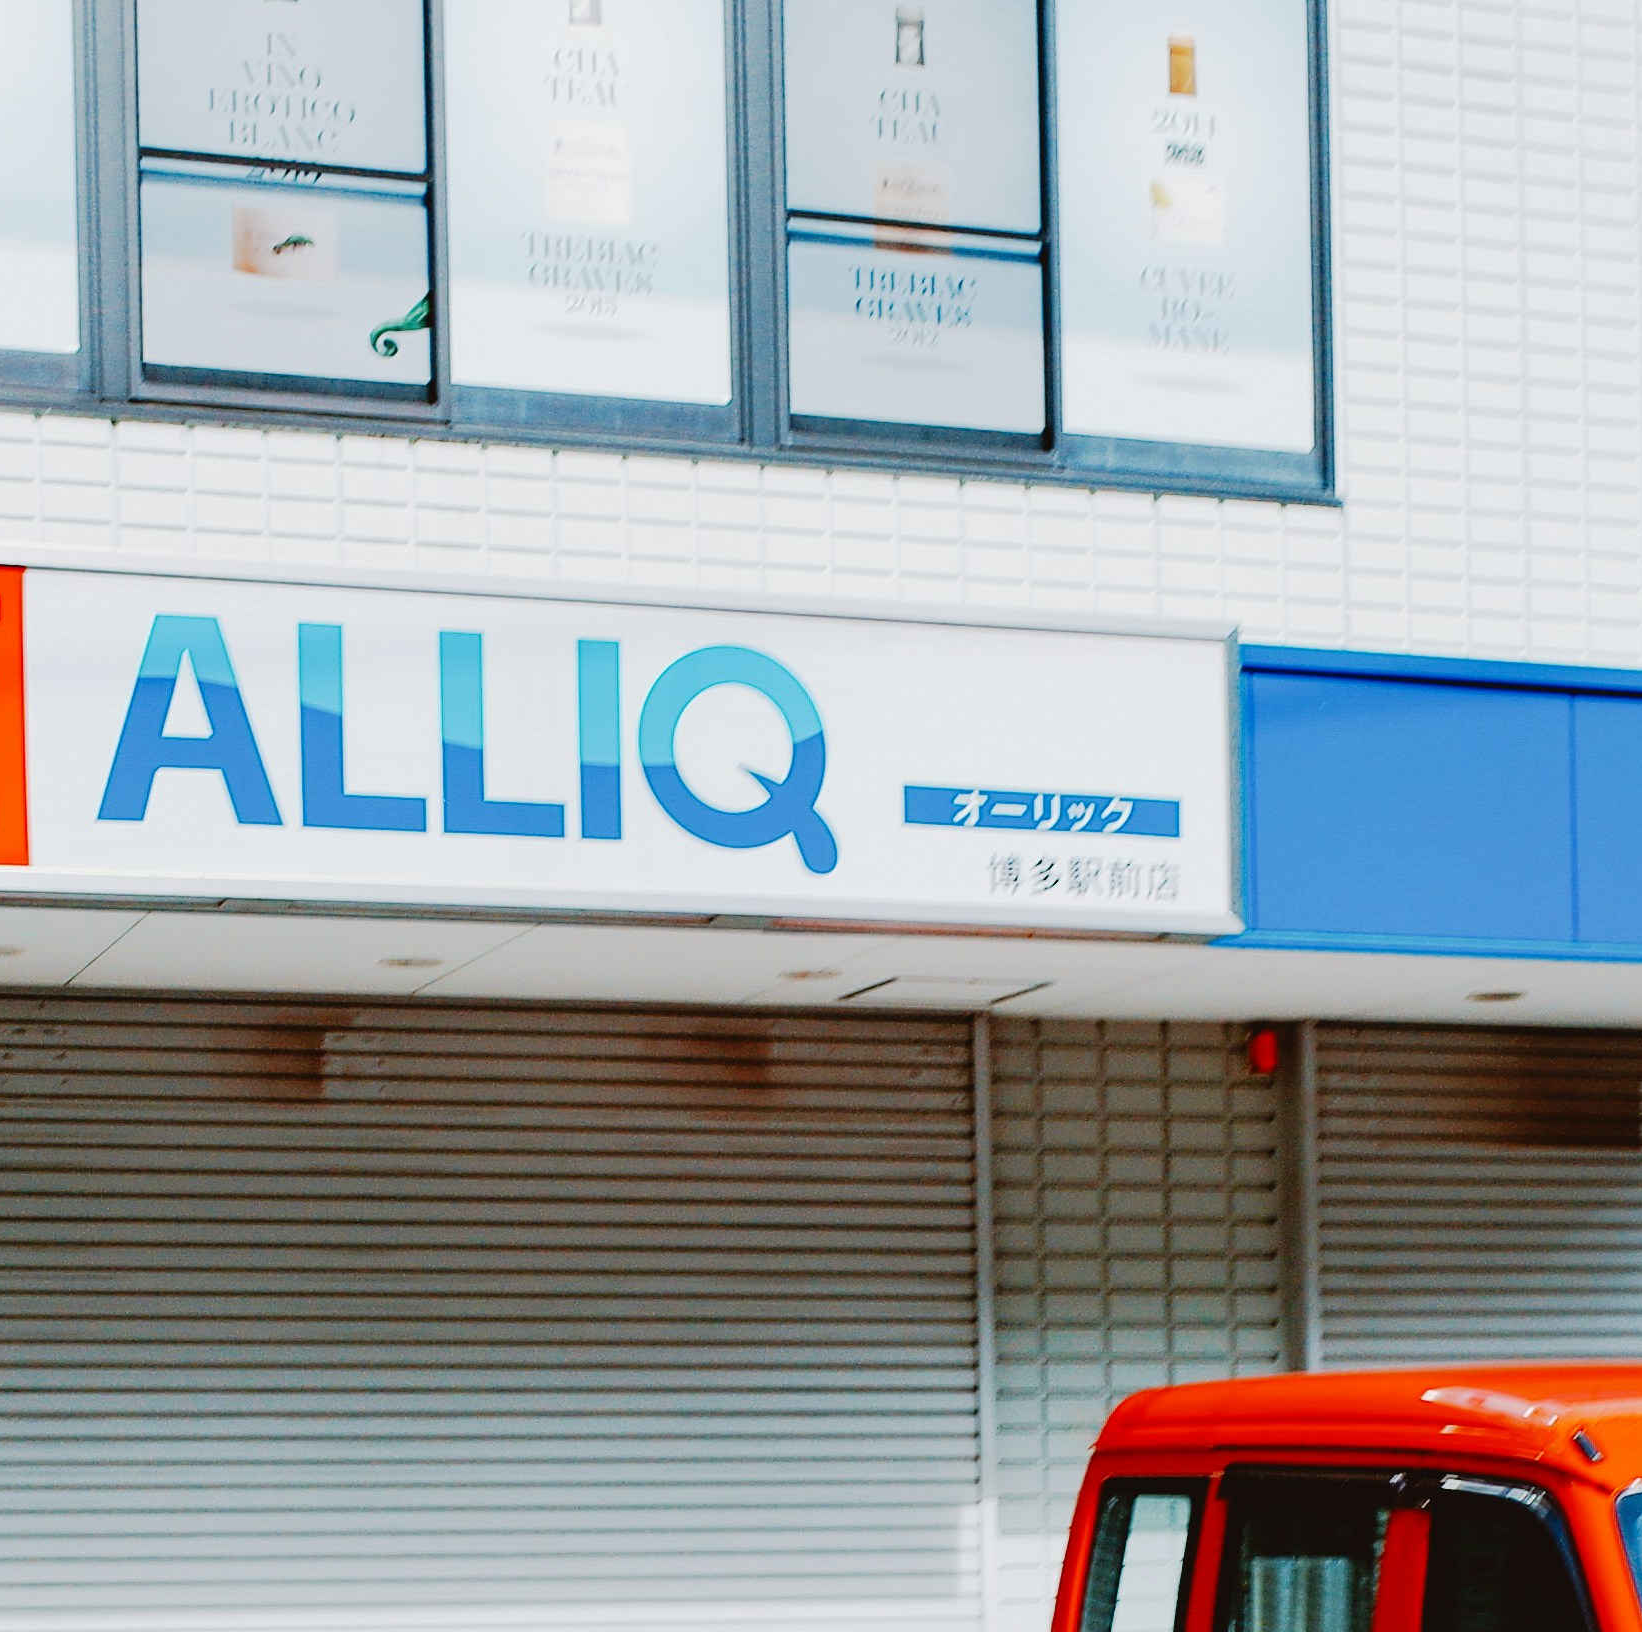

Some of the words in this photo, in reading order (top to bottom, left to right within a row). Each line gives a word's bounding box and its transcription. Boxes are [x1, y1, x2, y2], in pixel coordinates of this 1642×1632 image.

[266, 31, 297, 58] IN
[243, 60, 322, 90] VINO
[209, 87, 355, 124] EROTICO
[228, 119, 338, 153] BLANC
[527, 261, 655, 296] GRAVES
[97, 613, 838, 874] ALLIQ
[952, 789, 1134, 834] オーリック
[987, 851, 1183, 902] 博多駅前店
